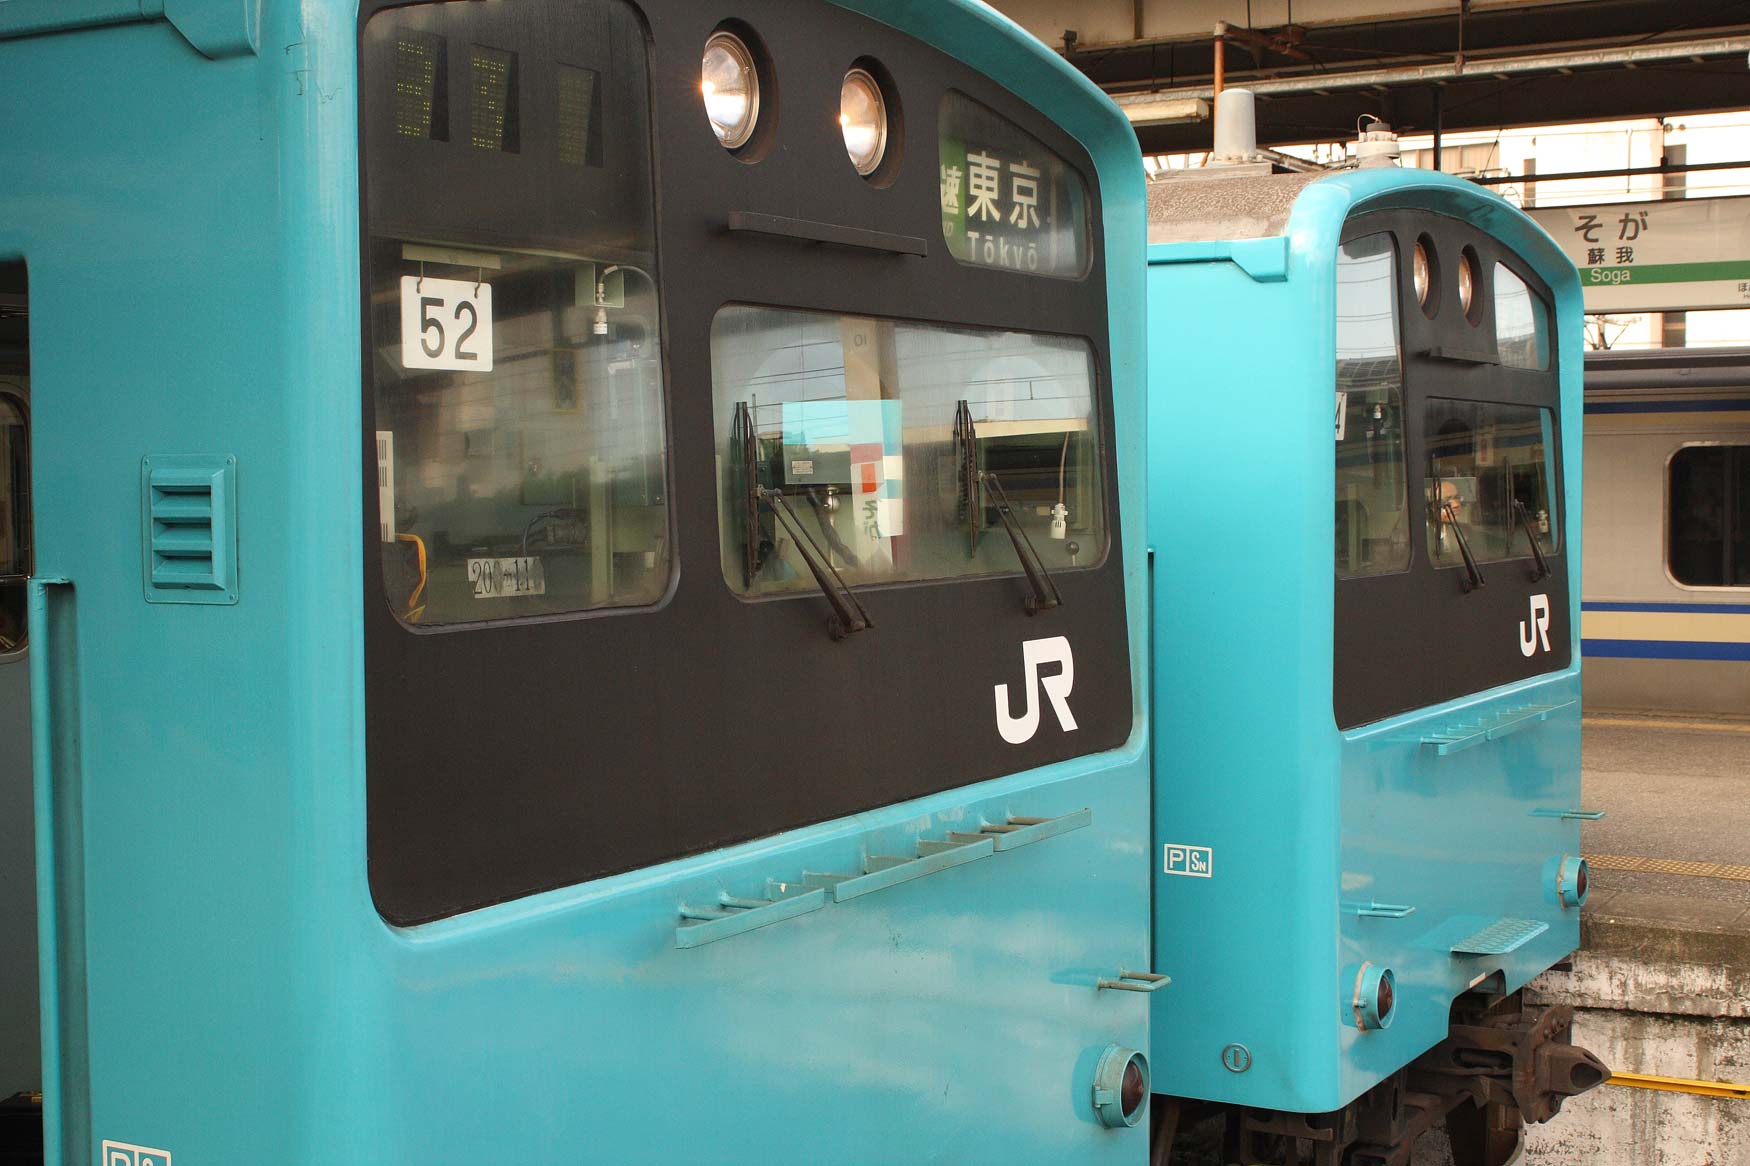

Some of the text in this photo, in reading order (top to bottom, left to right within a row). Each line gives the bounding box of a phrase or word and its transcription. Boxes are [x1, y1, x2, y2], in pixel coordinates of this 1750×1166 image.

[967, 151, 1041, 229] 東京
[1575, 210, 1649, 243] そが
[1588, 246, 1634, 265] 蘇我
[1591, 268, 1631, 285] Soga
[421, 296, 478, 360] 52
[1519, 593, 1551, 657] JR
[994, 635, 1079, 744] JR
